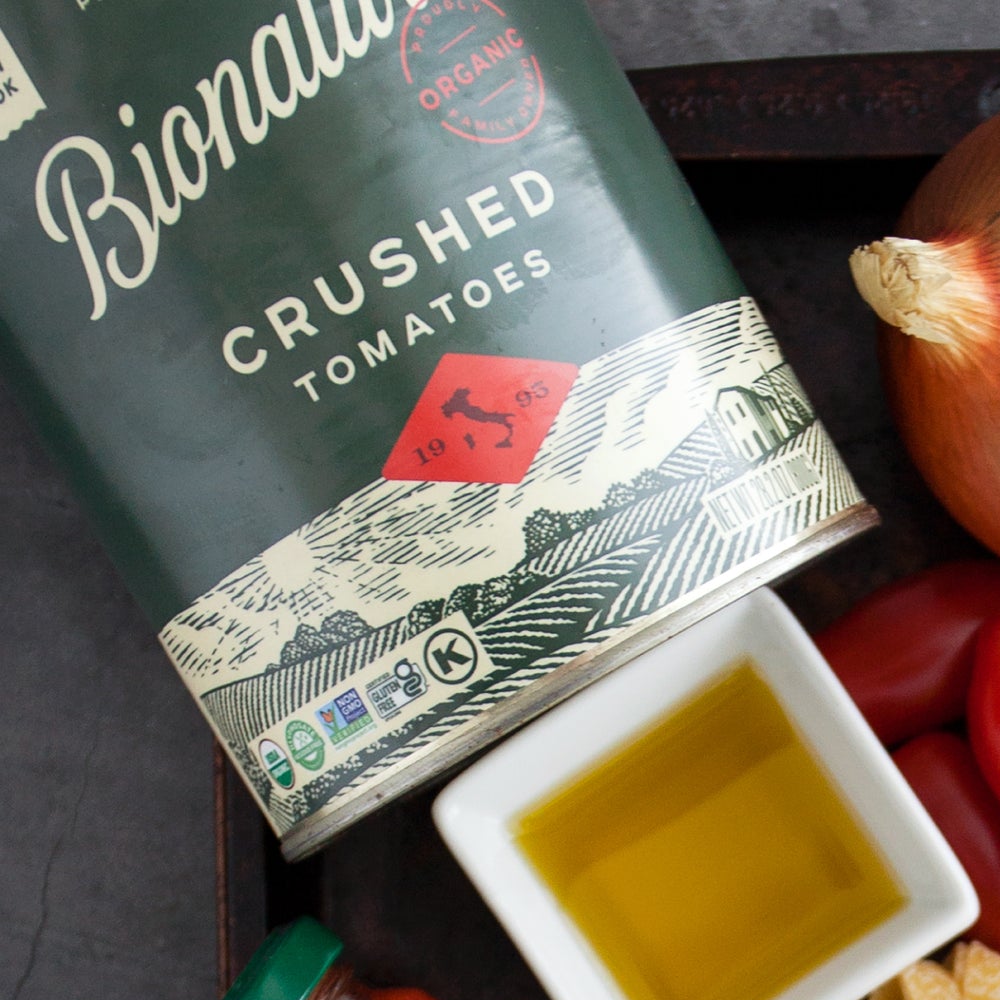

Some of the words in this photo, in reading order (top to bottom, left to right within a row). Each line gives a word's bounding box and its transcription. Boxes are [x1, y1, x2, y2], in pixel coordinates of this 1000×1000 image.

[418, 27, 524, 111] ORGANIC
[222, 169, 555, 375] CRUSHED
[293, 249, 552, 402] TOMATOES
[412, 438, 446, 466] 19
[515, 380, 549, 408] 95
[431, 637, 473, 676] K
[336, 690, 358, 707] NON
[341, 699, 361, 716] GMO
[371, 679, 402, 703] GLUTEN
[377, 697, 397, 714] FREE
